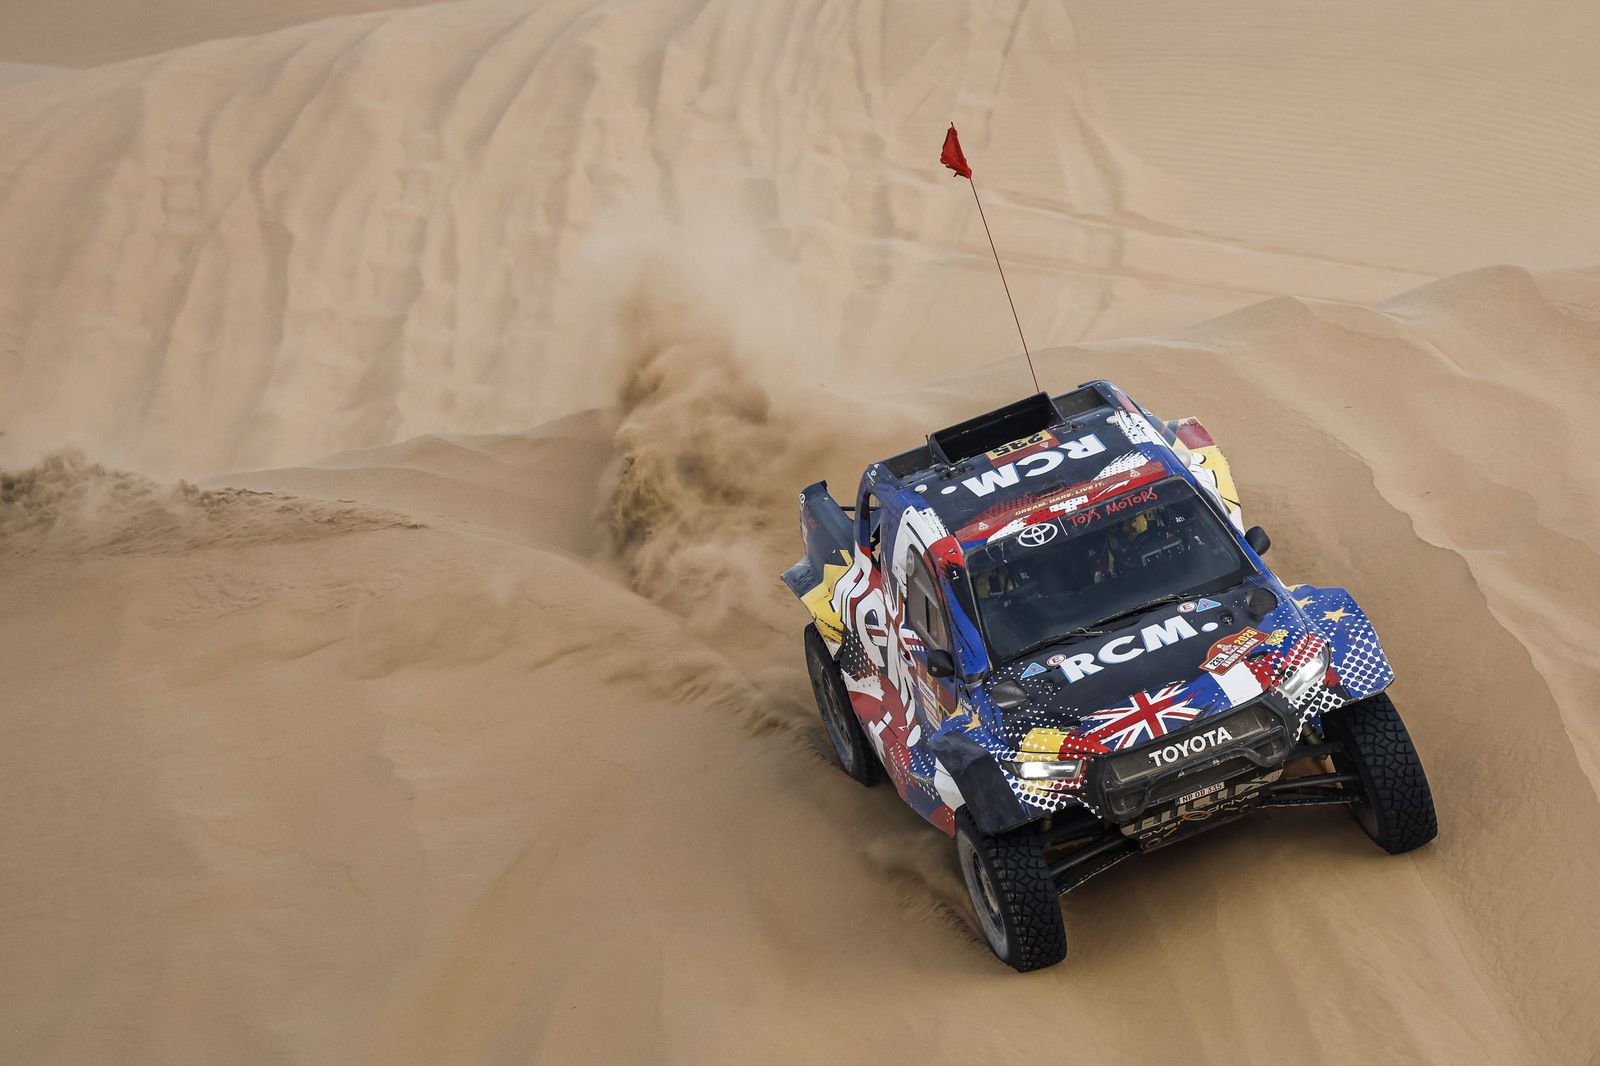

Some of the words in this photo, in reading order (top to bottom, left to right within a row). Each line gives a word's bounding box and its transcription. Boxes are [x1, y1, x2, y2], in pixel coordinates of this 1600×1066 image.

[1015, 501, 1048, 516] DREAM.
[1075, 485, 1094, 496] LIVE
[1094, 481, 1105, 491] IT.
[1059, 615, 1219, 684] RCM.
[1234, 629, 1258, 646] 2026
[1210, 656, 1225, 667] 235
[1148, 726, 1233, 768] TOYOTA
